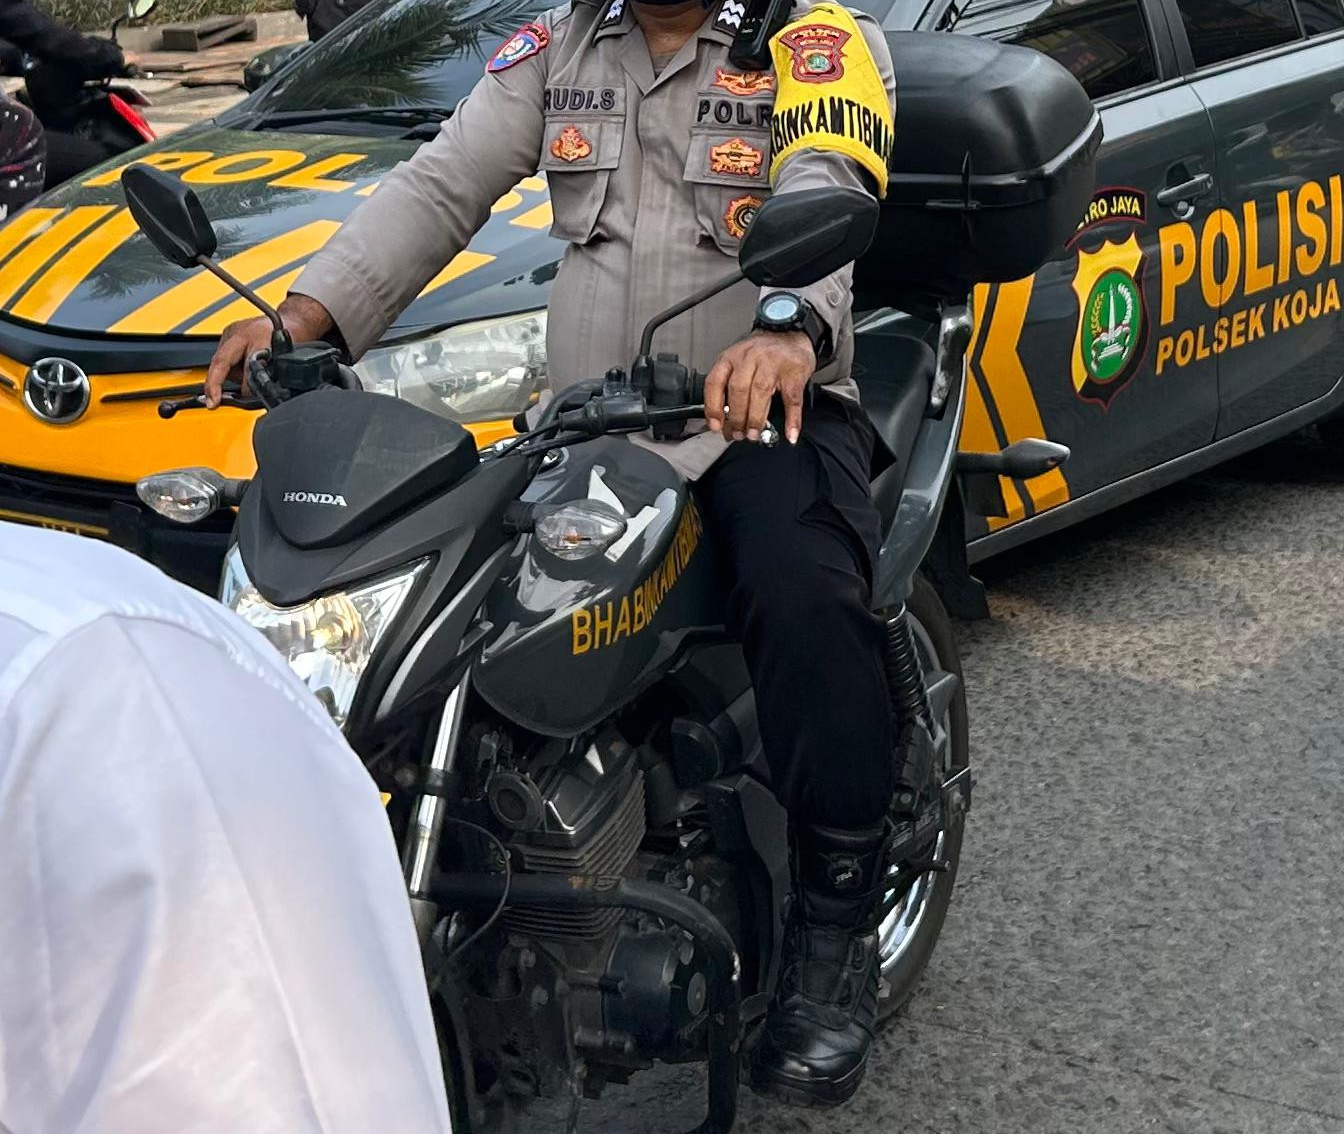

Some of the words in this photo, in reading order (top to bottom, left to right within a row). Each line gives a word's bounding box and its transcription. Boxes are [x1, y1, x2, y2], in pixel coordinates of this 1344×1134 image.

[697, 100, 773, 129] POLR
[770, 96, 895, 168] BINKAMTIBMA
[1077, 198, 1108, 230] TRO
[1110, 195, 1141, 216] JAYA
[1158, 174, 1344, 327] POLISI
[1156, 302, 1266, 375] POLSEK
[1272, 278, 1342, 333] KOJA
[283, 491, 348, 507] HONDA
